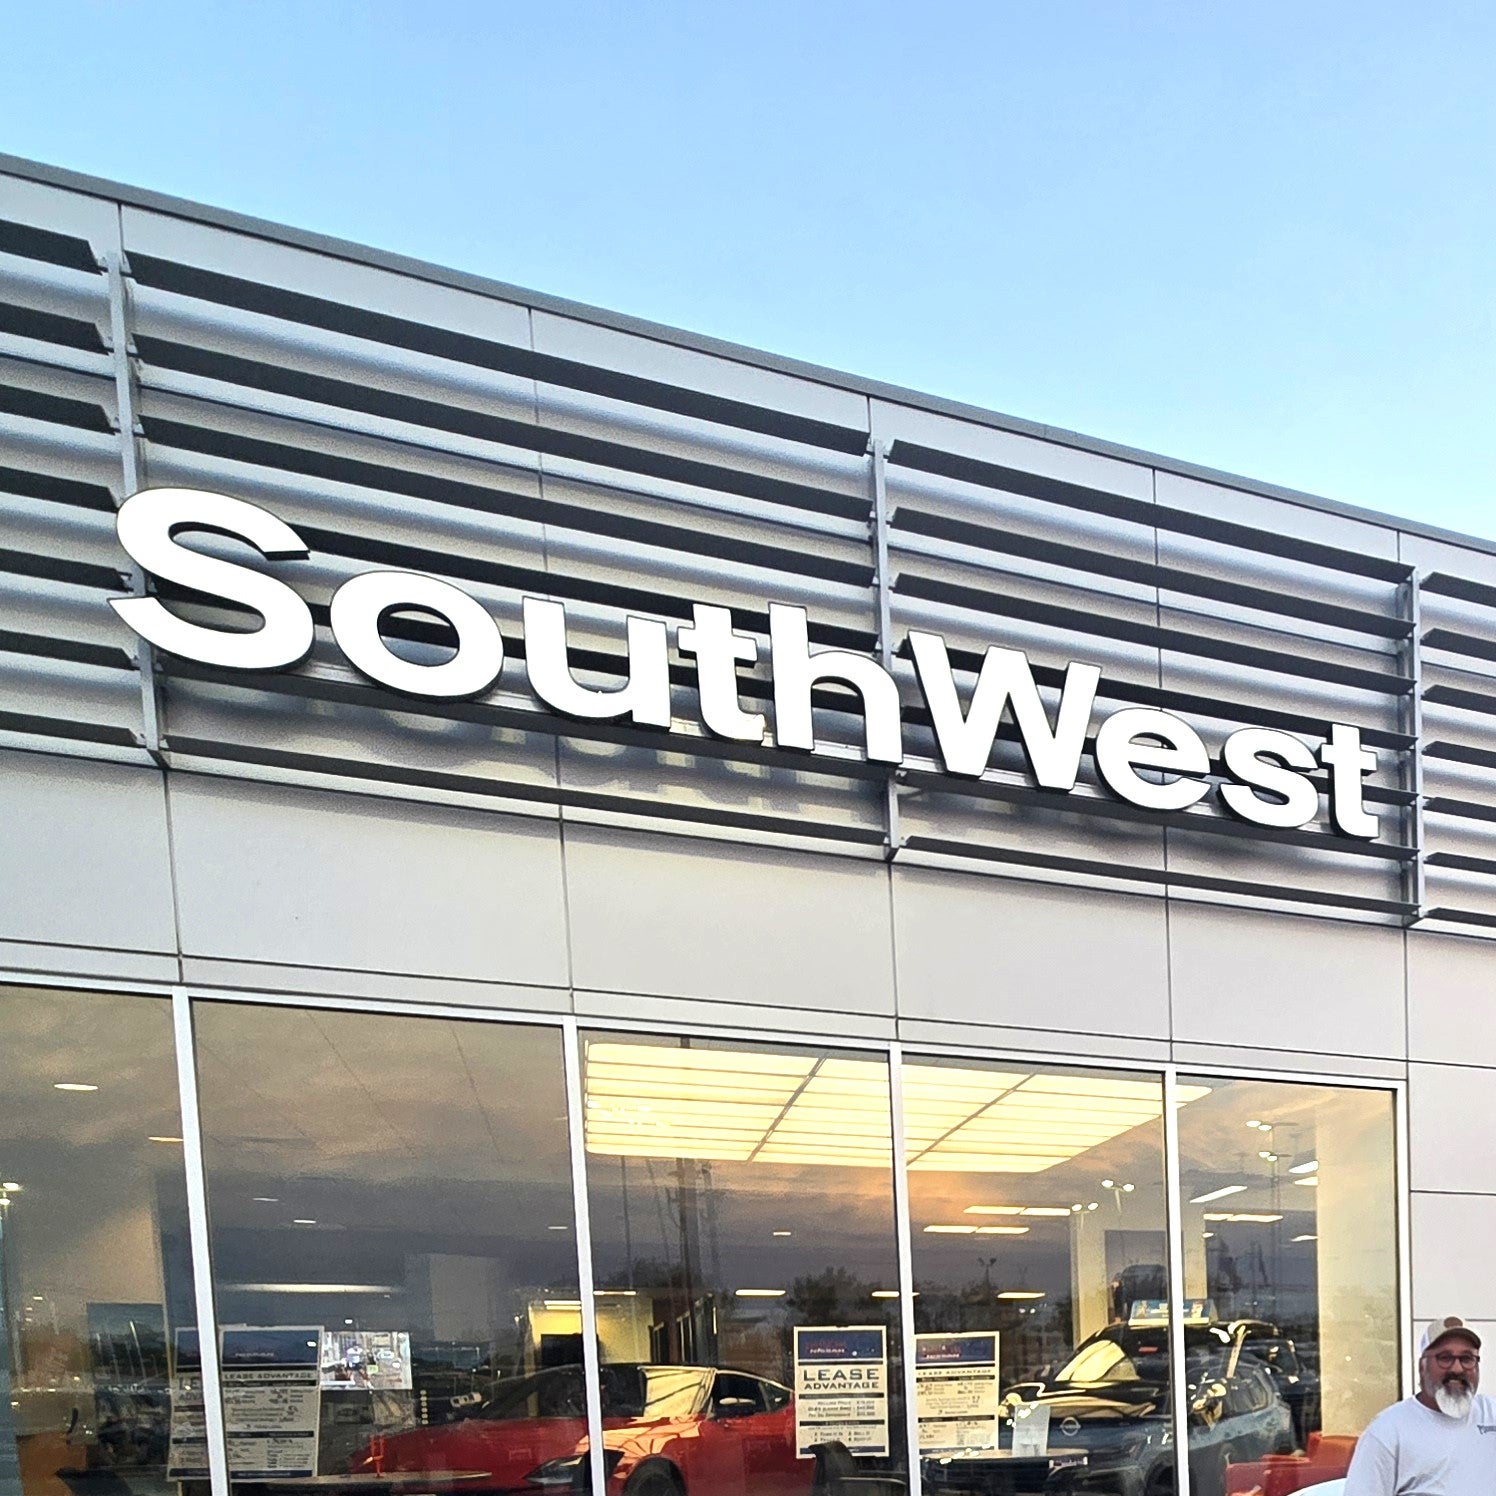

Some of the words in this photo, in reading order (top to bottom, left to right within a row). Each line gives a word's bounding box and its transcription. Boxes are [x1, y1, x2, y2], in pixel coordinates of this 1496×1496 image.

[107, 486, 1379, 838] SouthWest
[803, 1369, 880, 1381] LEASE
[804, 1382, 879, 1390] ADVANTAGE
